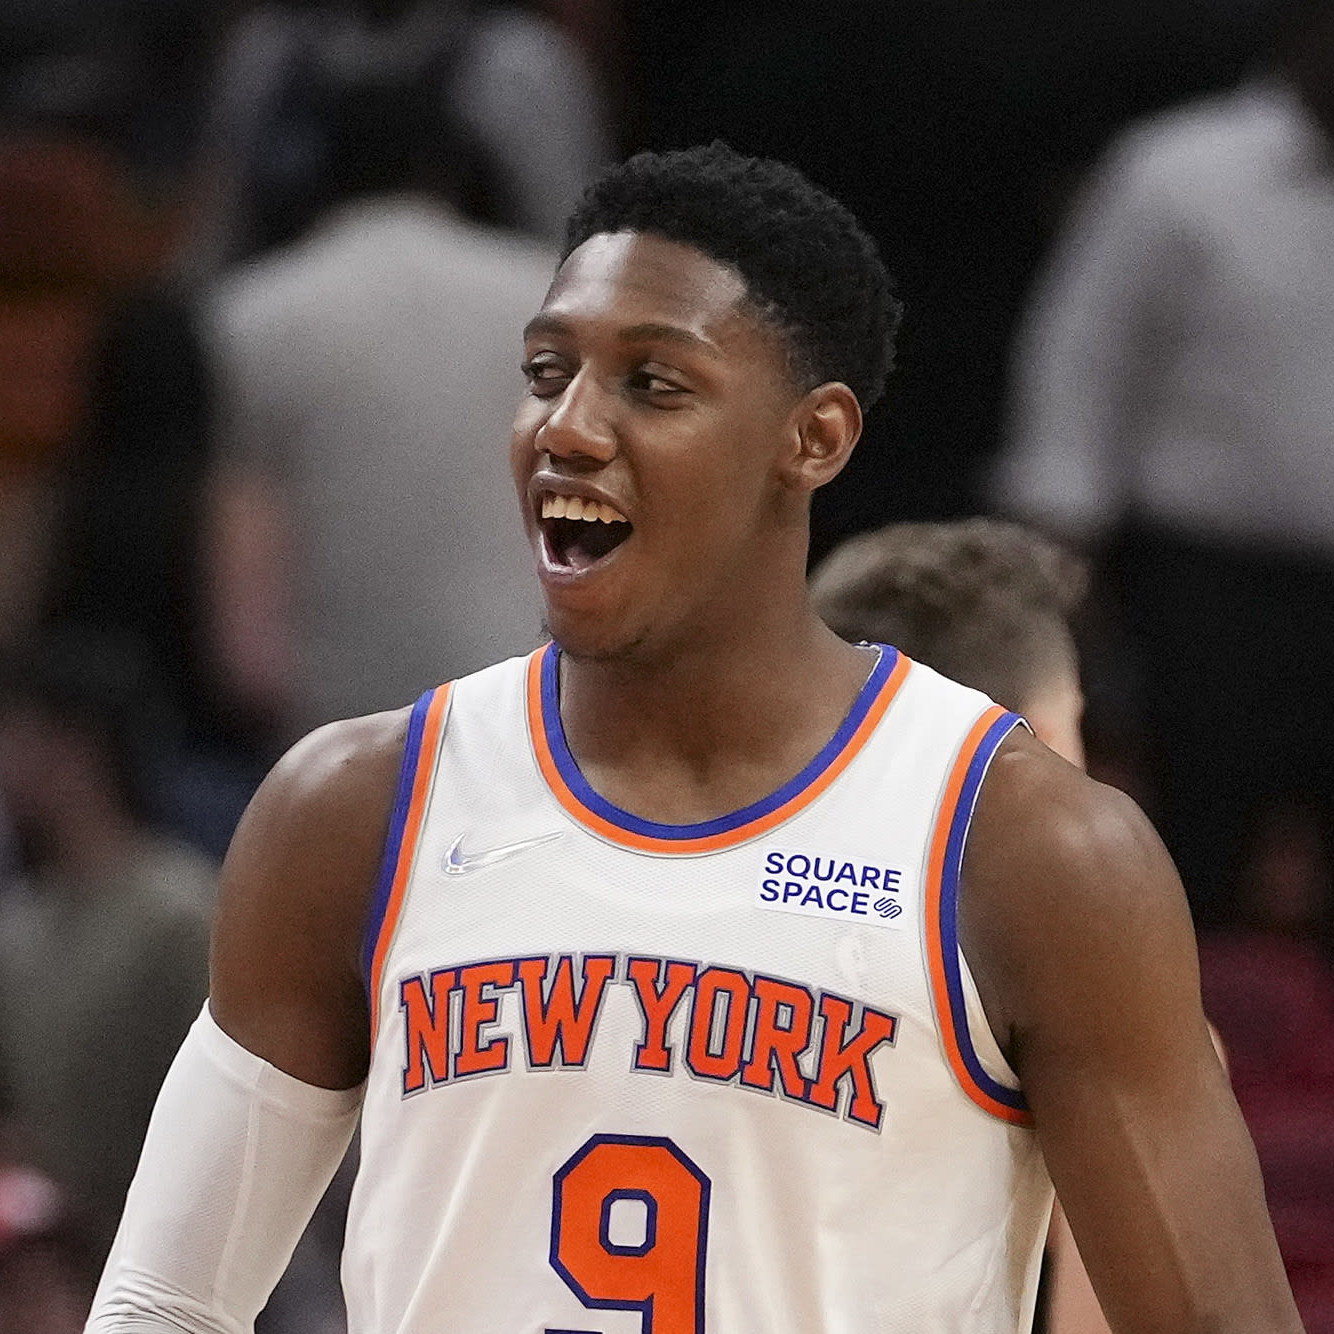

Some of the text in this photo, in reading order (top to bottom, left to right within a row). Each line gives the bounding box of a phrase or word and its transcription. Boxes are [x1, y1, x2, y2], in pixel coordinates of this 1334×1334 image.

[764, 852, 903, 893] SQUARE
[759, 879, 871, 915] SPACE
[399, 953, 901, 1135] NEW YORK
